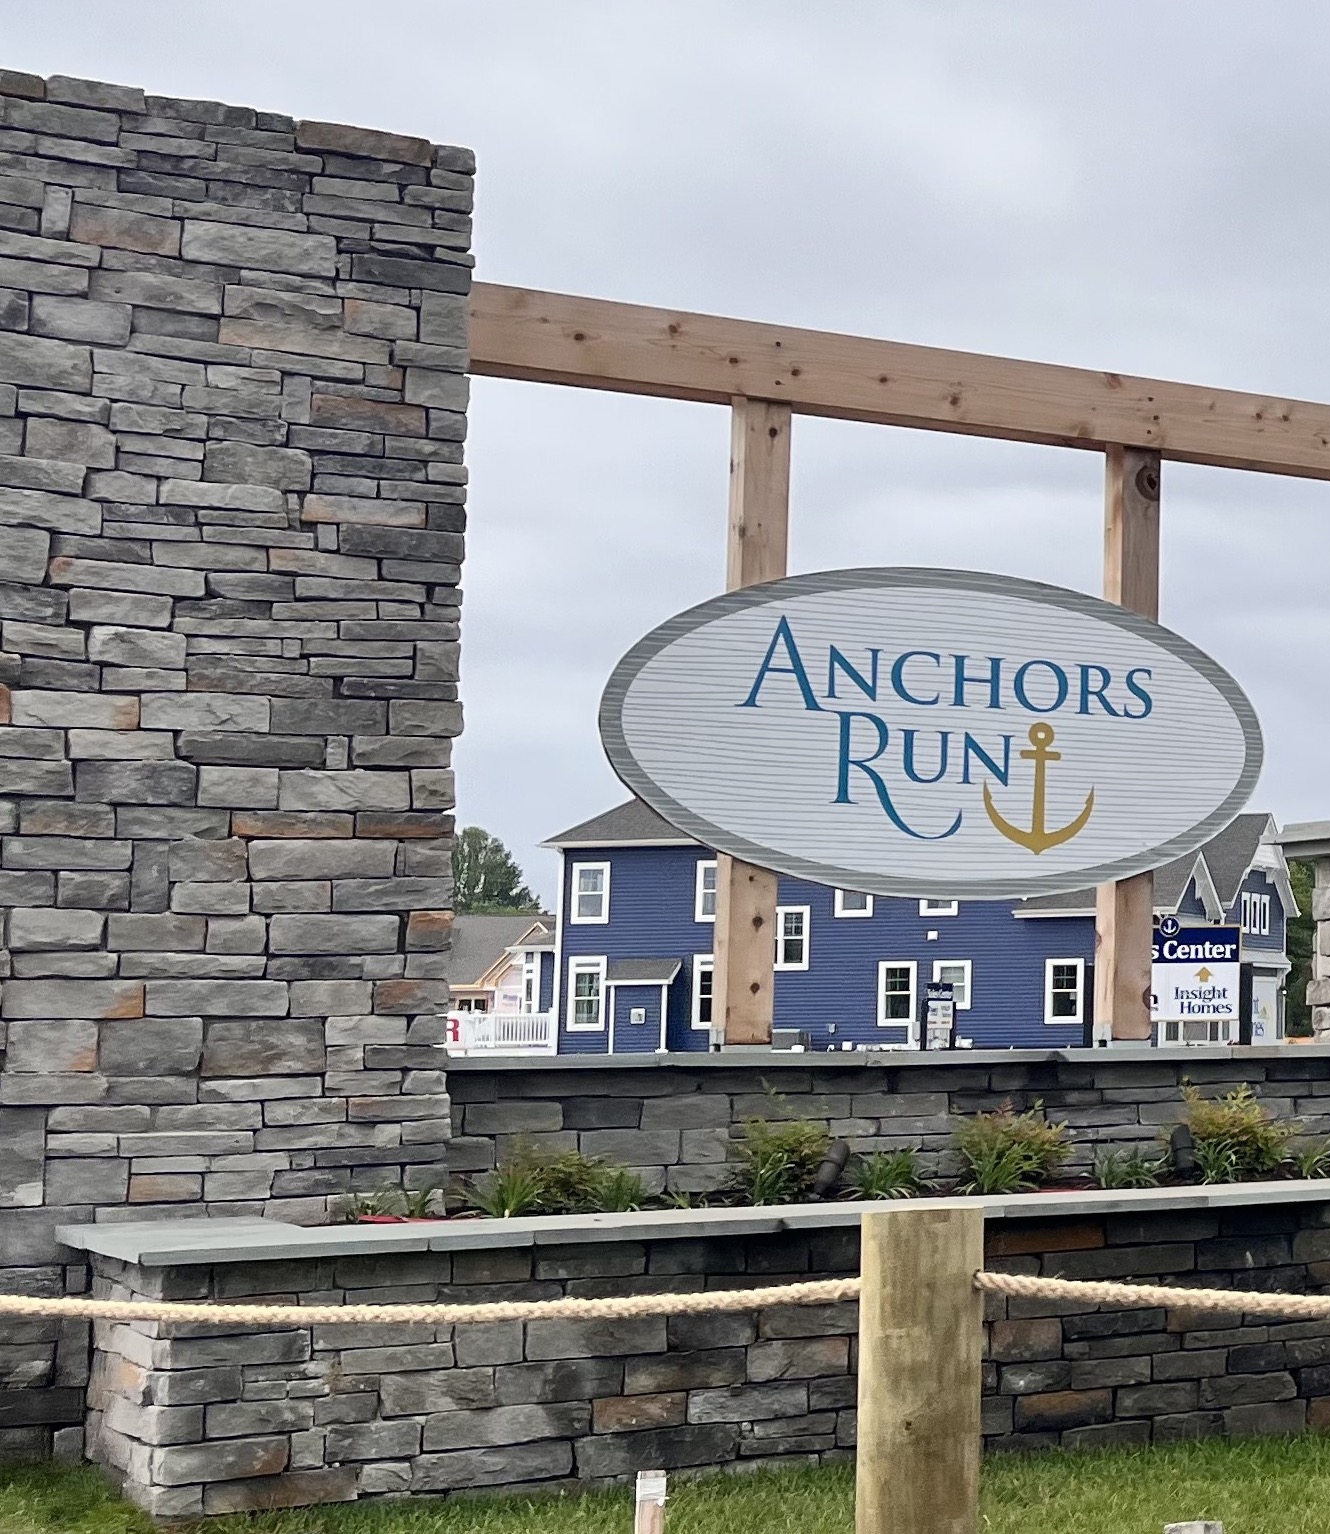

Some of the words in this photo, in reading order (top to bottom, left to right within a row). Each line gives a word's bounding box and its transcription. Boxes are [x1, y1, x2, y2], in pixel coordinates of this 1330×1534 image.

[735, 614, 1154, 719] ANCHORS
[827, 711, 1014, 840] RUN
[1162, 940, 1237, 960] Center
[1174, 986, 1228, 1003] Insight
[1179, 1001, 1233, 1014] Homes
